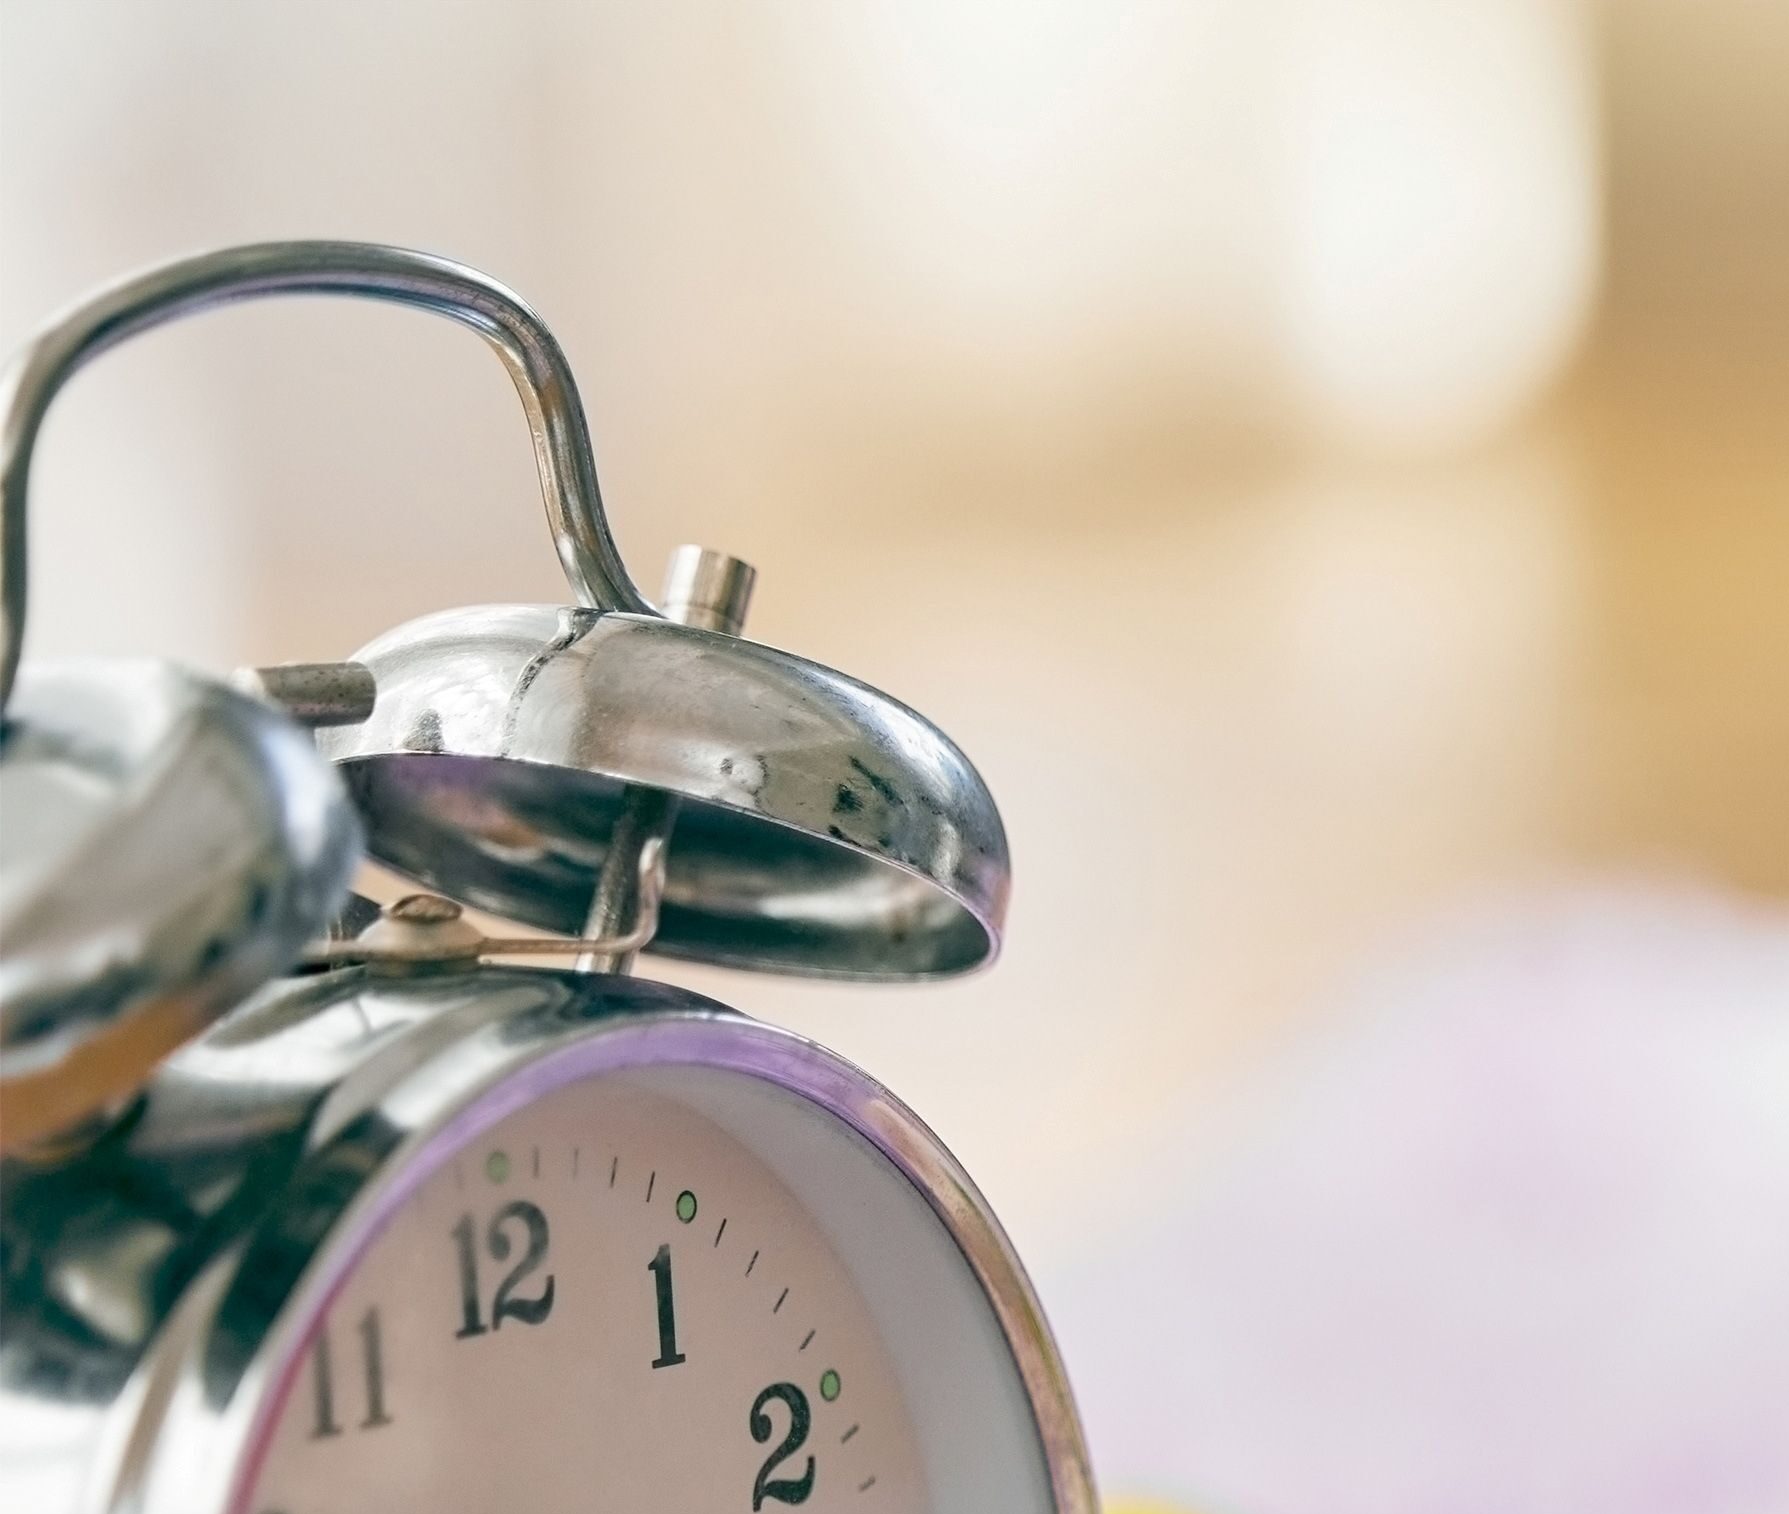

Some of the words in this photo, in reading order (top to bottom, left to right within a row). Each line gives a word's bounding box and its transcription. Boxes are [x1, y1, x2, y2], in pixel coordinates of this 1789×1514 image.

[451, 1201, 555, 1340] 12
[647, 1244, 686, 1368] 1
[308, 1304, 393, 1441] 11
[748, 1381, 816, 1513] 2
